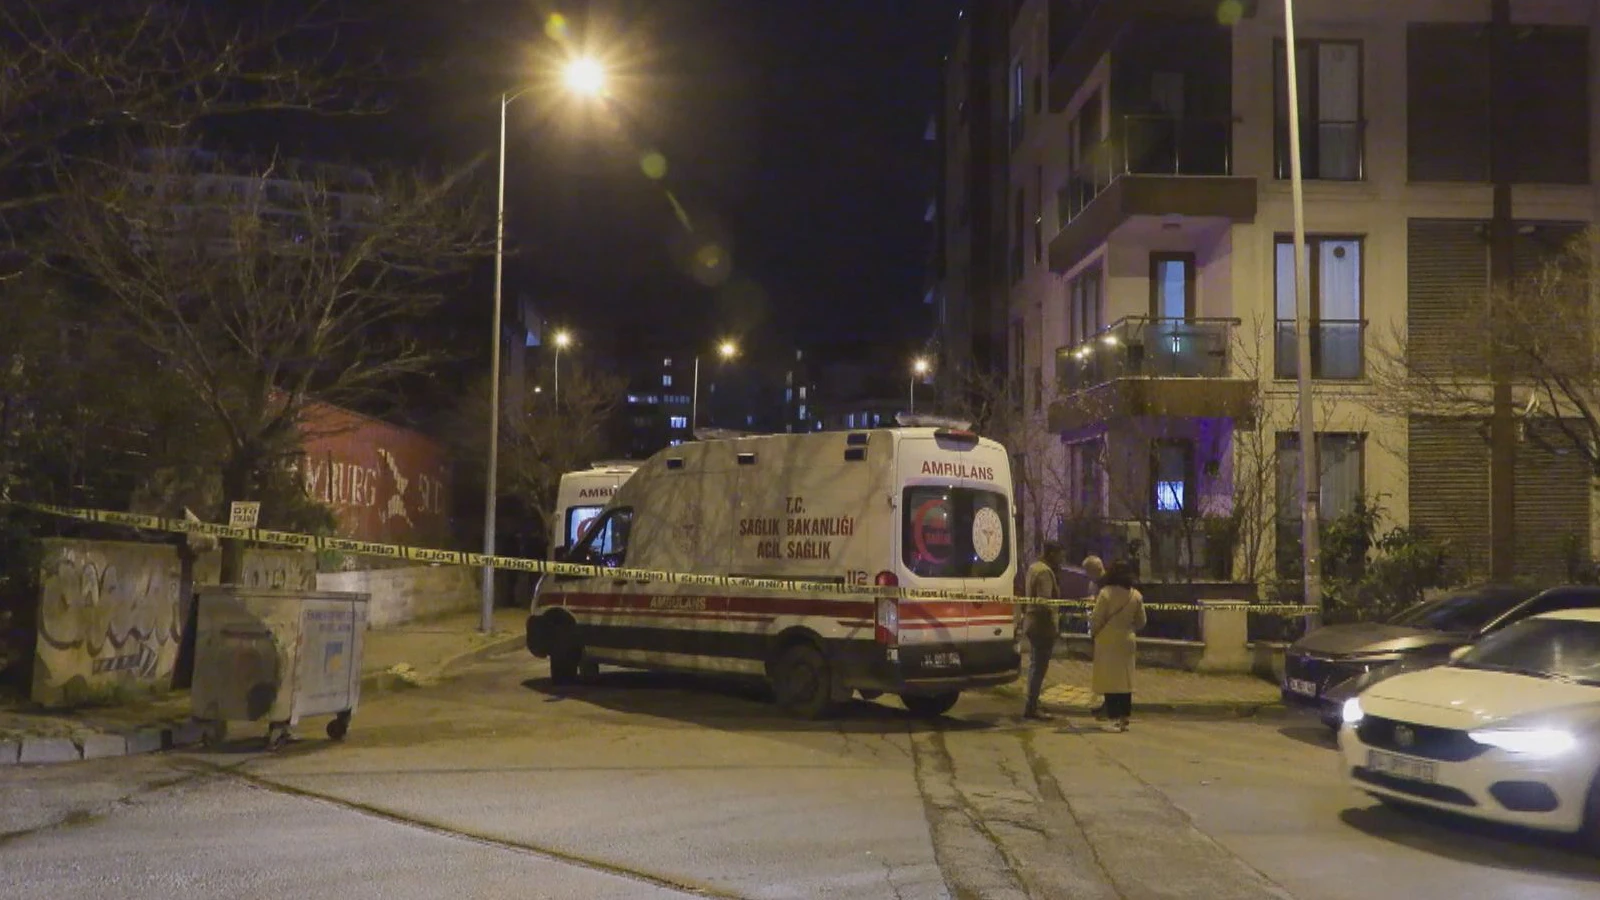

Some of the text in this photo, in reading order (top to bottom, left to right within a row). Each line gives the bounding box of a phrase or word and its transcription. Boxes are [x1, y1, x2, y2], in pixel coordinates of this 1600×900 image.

[921, 461, 994, 480] AMBULANS
[785, 497, 806, 514] T.C.
[740, 516, 854, 536] SAĞLIK BAKANLIĞI
[787, 538, 831, 559] SAĞLIK
[846, 570, 868, 585] 112
